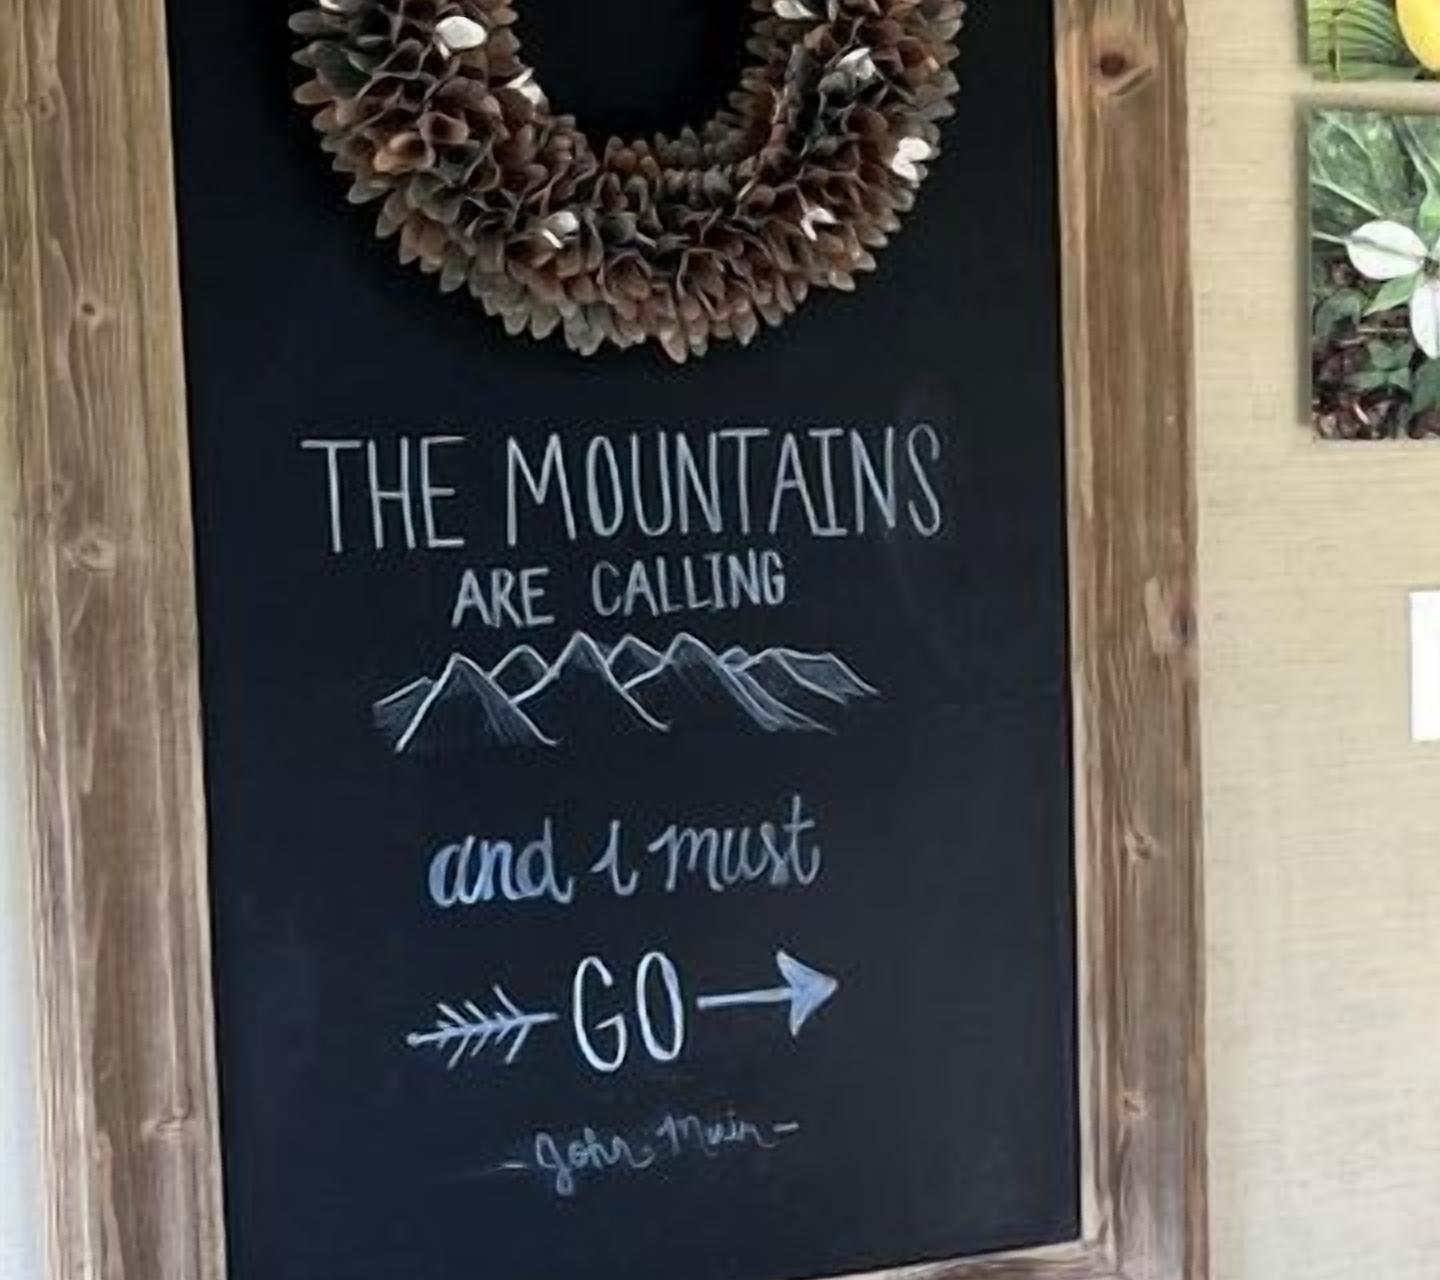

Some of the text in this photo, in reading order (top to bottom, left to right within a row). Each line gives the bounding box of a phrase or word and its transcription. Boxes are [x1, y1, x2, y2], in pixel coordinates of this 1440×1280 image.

[301, 423, 943, 552] THE MOUNTAINS
[451, 548, 787, 628] ARE CALLING
[429, 817, 574, 907] and
[648, 794, 821, 892] must
[573, 951, 685, 1072] GO
